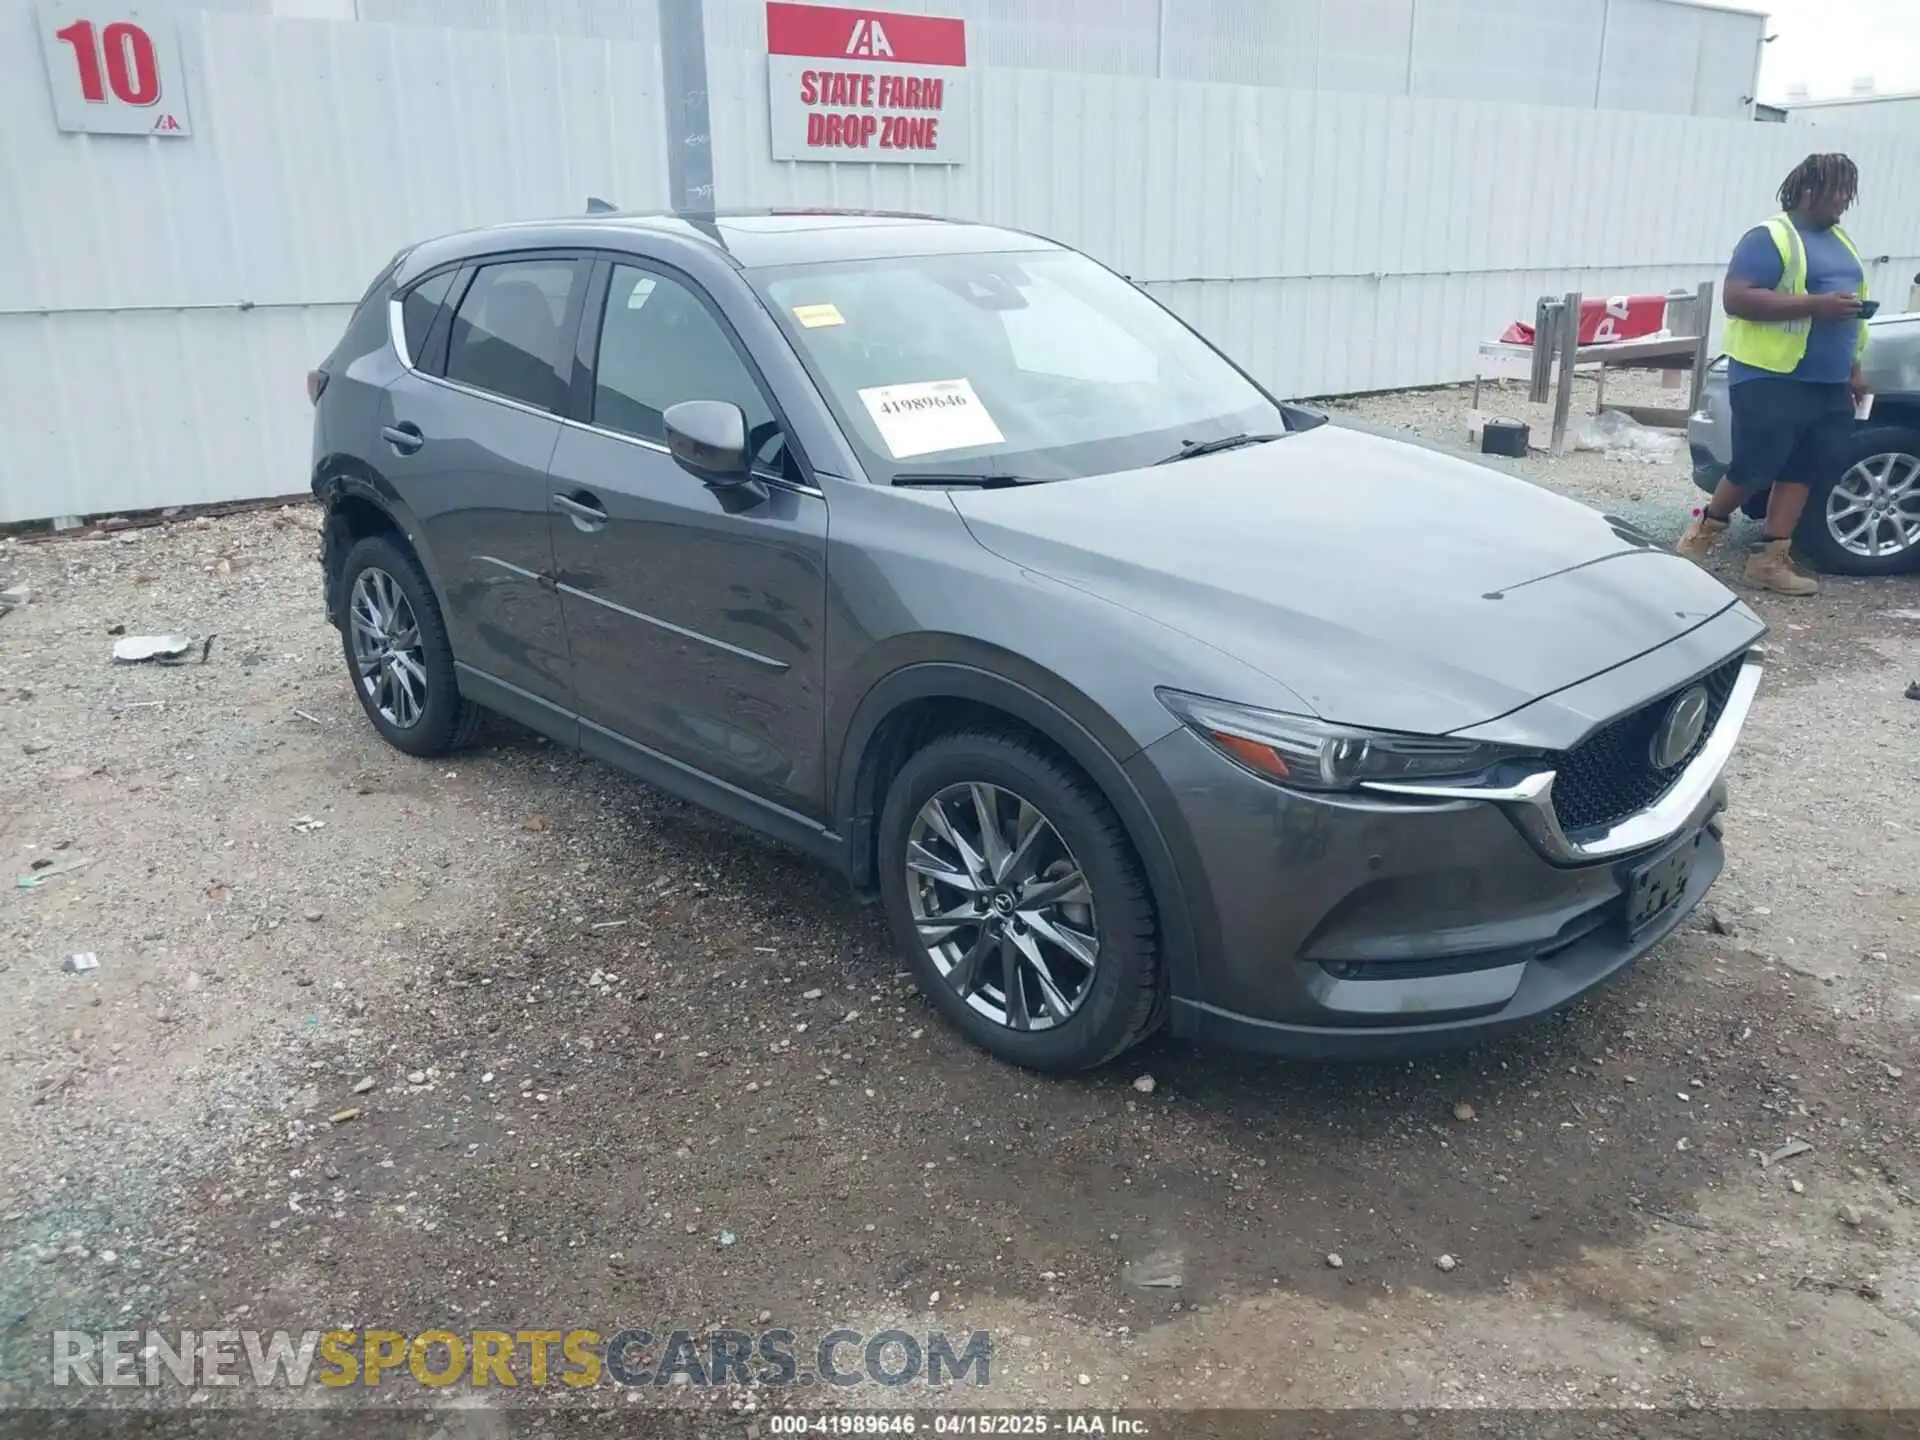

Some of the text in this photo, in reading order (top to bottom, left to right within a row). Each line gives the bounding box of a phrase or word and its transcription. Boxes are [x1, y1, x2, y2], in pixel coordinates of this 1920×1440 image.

[56, 19, 162, 108] 10
[800, 70, 944, 111] STATE FARM
[807, 113, 939, 151] DROP ZONE
